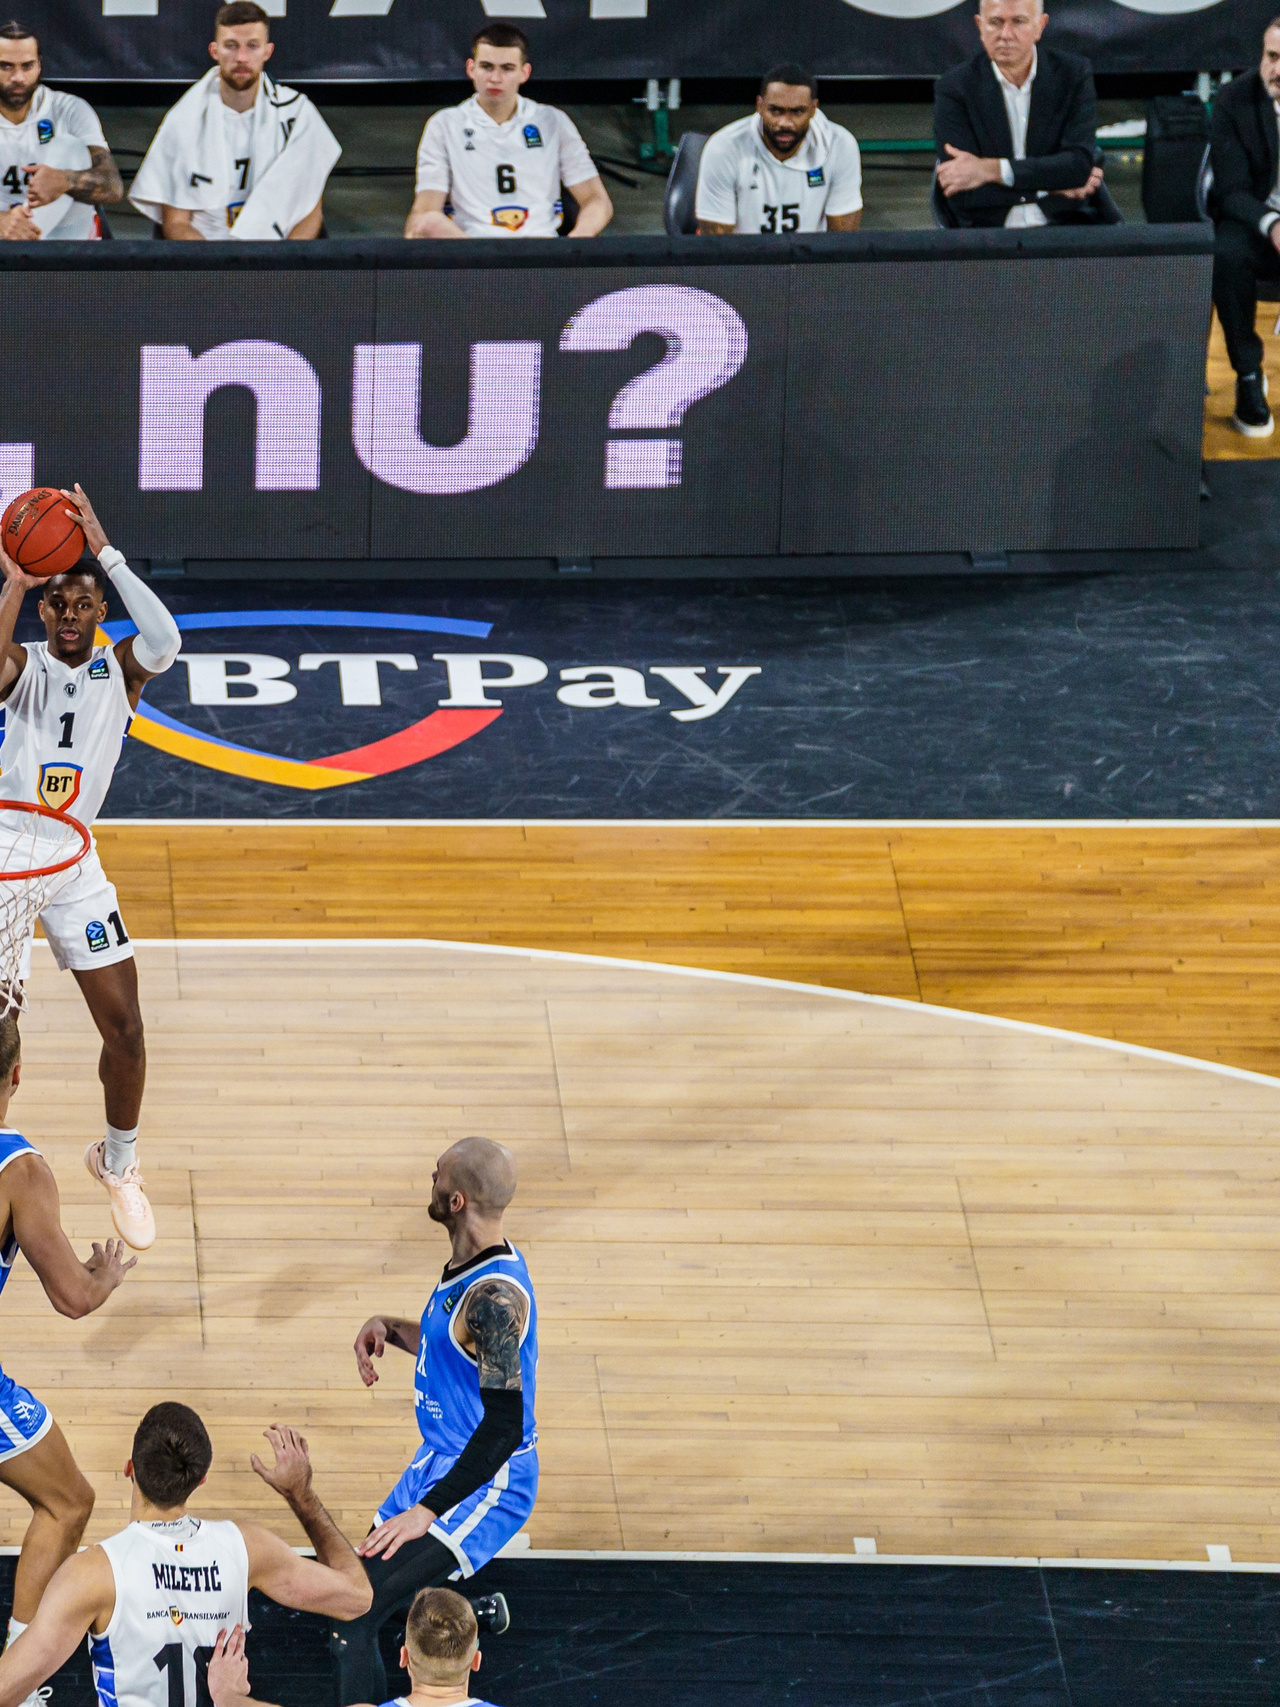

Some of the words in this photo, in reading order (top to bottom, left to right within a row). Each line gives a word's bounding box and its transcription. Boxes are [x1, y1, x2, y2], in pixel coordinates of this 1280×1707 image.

[2, 163, 36, 195] 4
[235, 158, 250, 190] 7
[497, 164, 517, 194] 6
[761, 203, 799, 233] 35
[138, 284, 749, 496] nu?
[58, 711, 75, 748] 1
[46, 775, 72, 792] BT
[107, 910, 129, 947] 1
[152, 1560, 222, 1592] MILETIĆ
[147, 1610, 169, 1619] BANCA
